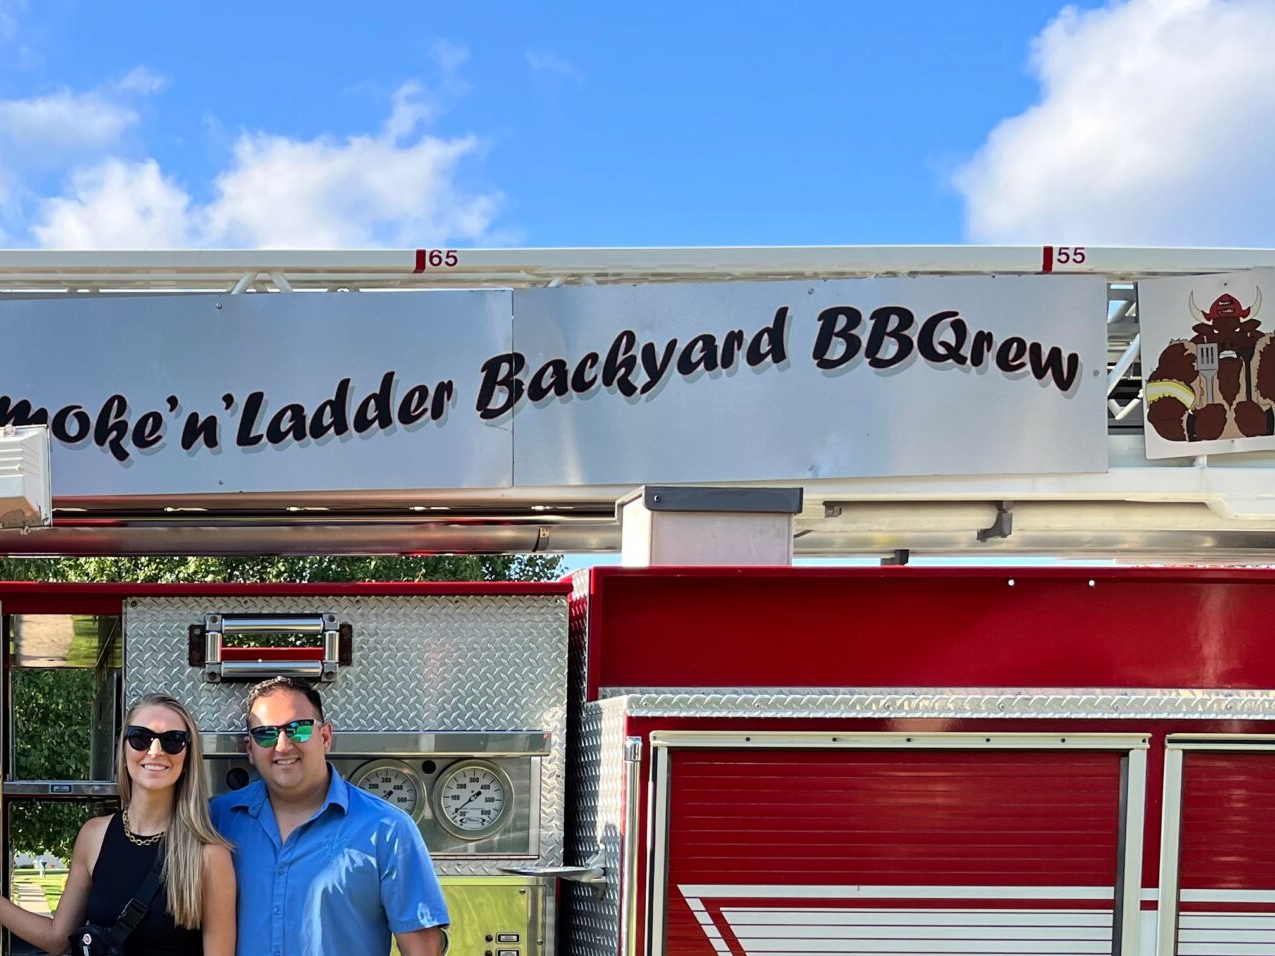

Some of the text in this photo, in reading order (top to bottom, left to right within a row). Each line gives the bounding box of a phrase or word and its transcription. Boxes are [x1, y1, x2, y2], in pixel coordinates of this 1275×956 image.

[428, 249, 458, 267] 65
[1057, 246, 1086, 264] 55
[476, 306, 789, 420] Backyard
[816, 305, 1079, 392] BBQrew
